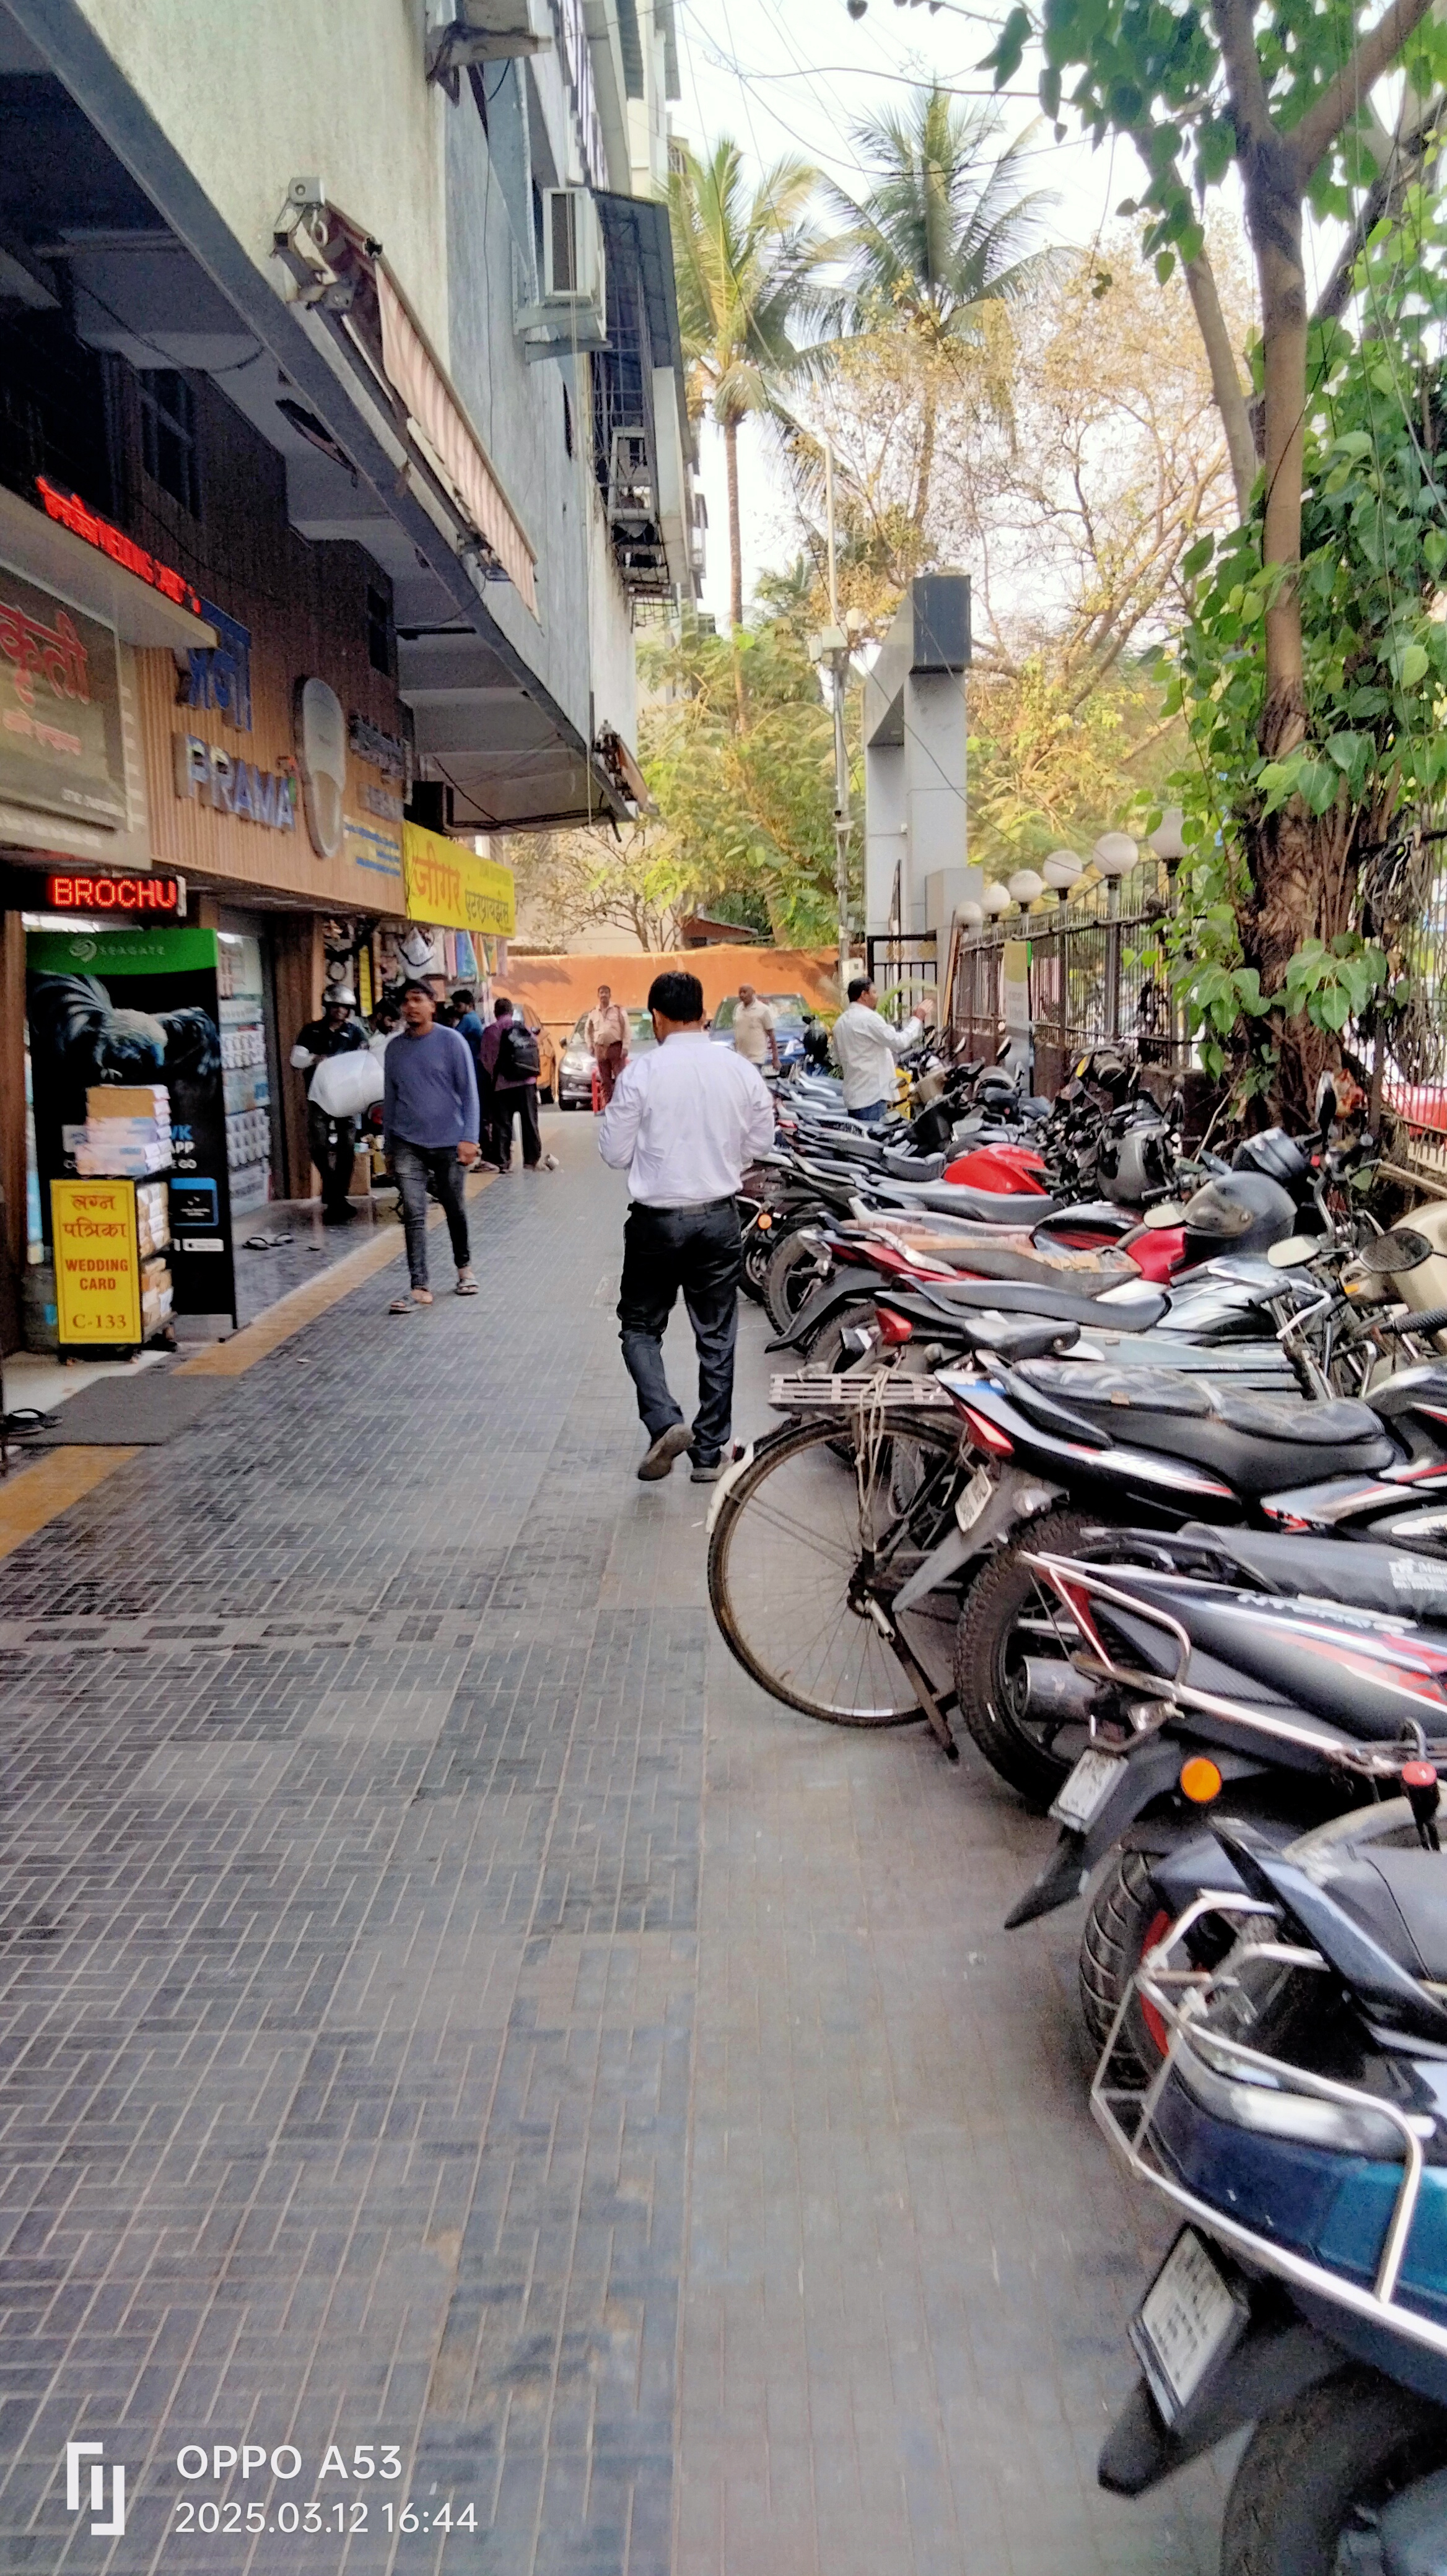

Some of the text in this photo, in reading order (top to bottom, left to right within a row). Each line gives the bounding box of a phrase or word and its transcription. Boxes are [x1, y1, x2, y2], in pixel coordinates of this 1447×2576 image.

[186, 734, 295, 830] PRAMA
[413, 840, 461, 916] जीगर
[54, 877, 177, 908] BROCHU
[71, 1194, 116, 1210] लग्न
[63, 1216, 127, 1238] पत्रिका
[65, 1258, 129, 1272] WEDDING
[79, 1277, 116, 1291] CARD
[72, 1313, 127, 1329] C-133
